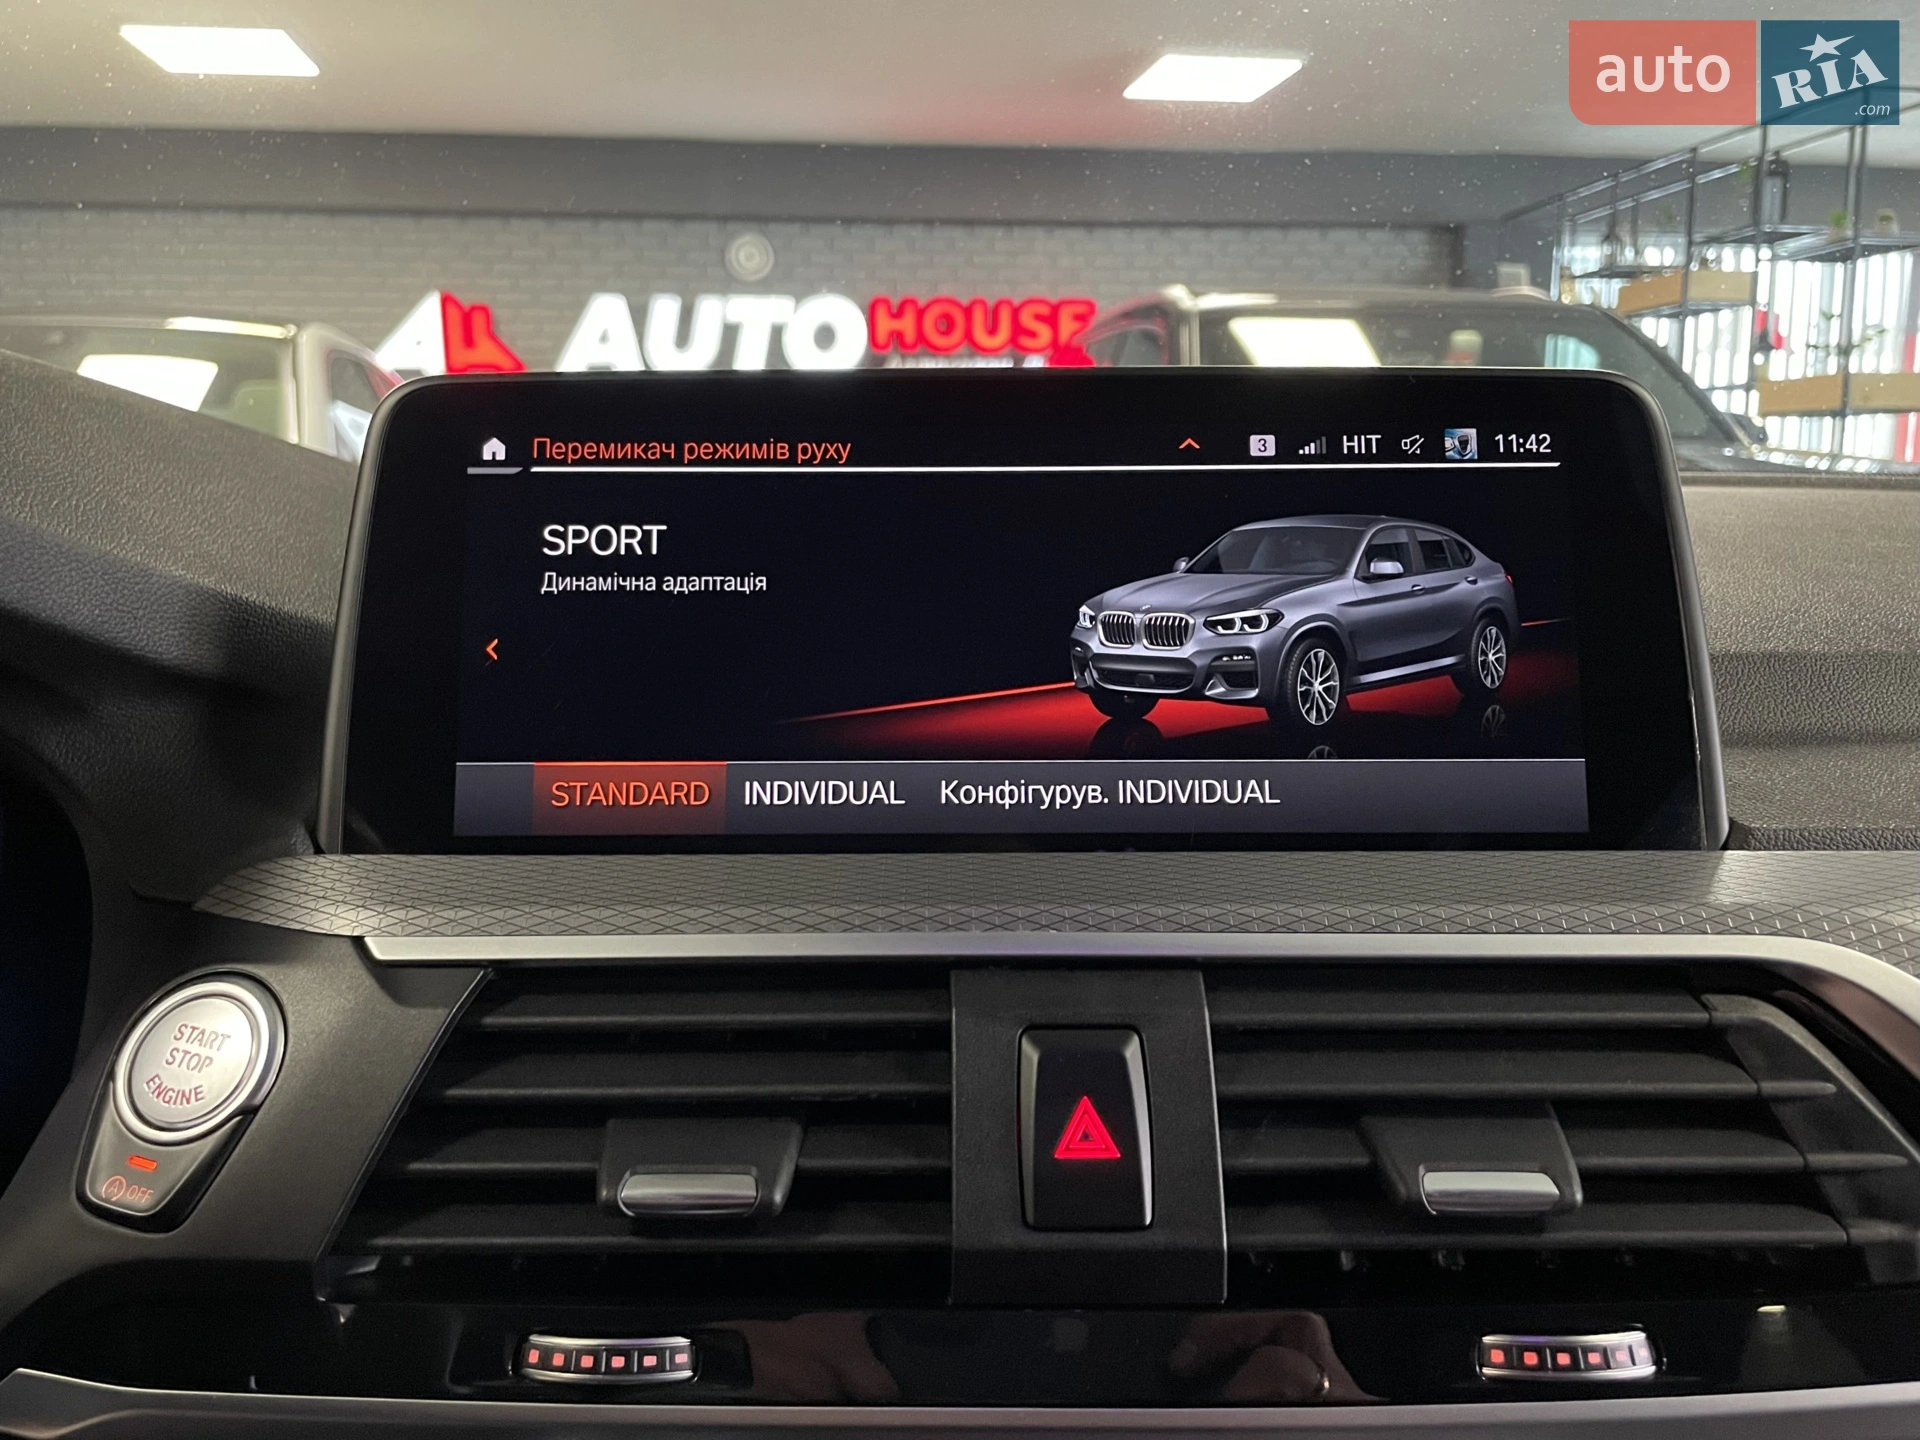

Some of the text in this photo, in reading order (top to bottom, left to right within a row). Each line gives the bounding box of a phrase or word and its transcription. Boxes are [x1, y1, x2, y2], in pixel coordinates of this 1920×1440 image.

[554, 293, 1096, 371] AUTO HOUSE
[532, 437, 852, 464] Перемикач режимів руху
[1257, 438, 1268, 453] 3
[1342, 435, 1382, 454] HIT
[1494, 433, 1552, 454] 11:42
[542, 524, 668, 556] SPORT
[541, 572, 767, 595] Динамічна адаптація
[550, 781, 711, 807] STANDARD
[743, 781, 906, 806] INDIVIDUAL
[939, 779, 1281, 811] Конфігурув. INDIVIDUAL
[173, 1023, 231, 1052] START
[165, 1047, 214, 1074] STOP
[144, 1073, 205, 1107] ENGINE
[126, 1184, 154, 1203] OFF
